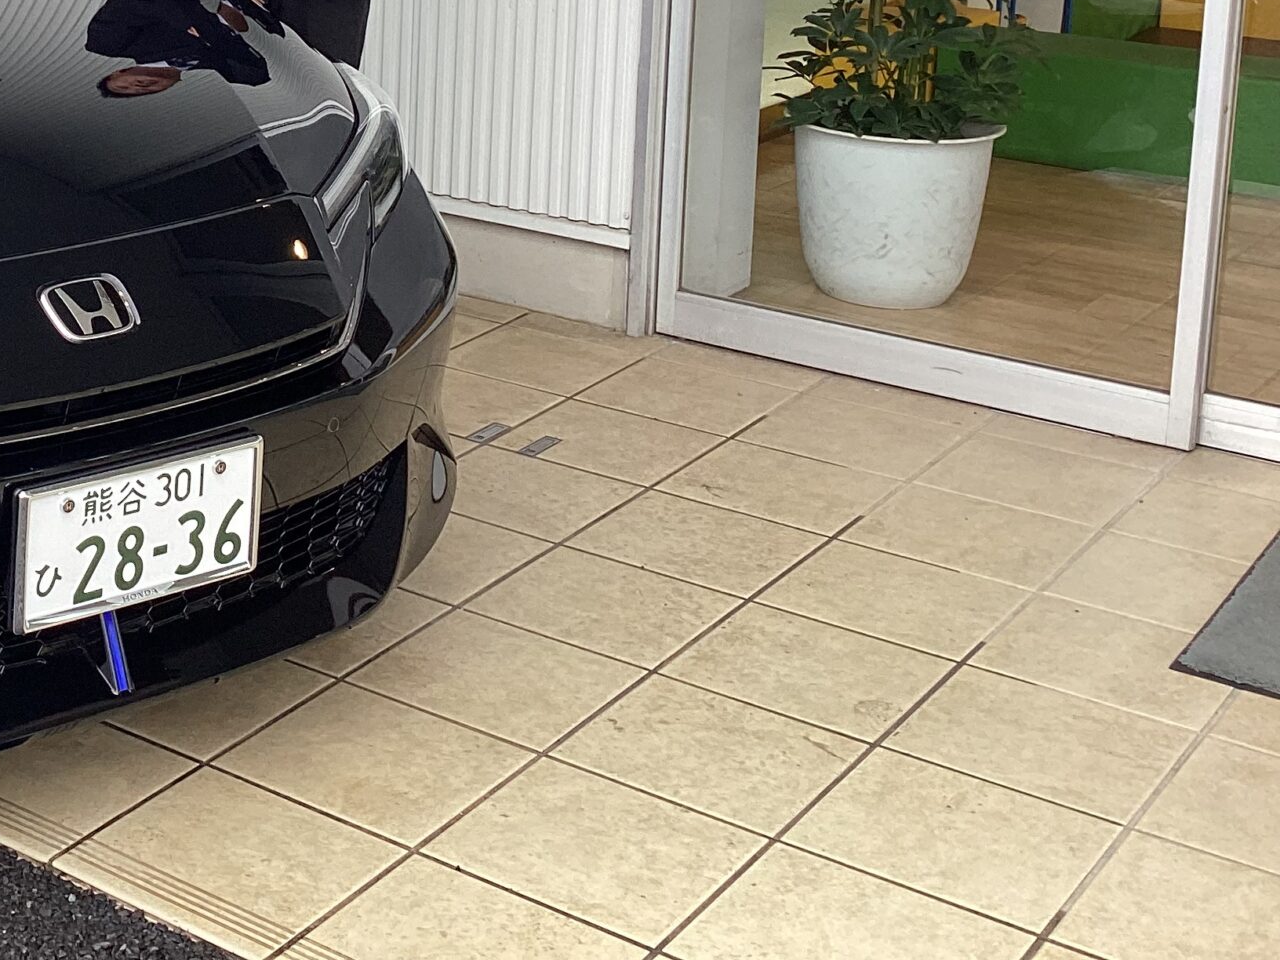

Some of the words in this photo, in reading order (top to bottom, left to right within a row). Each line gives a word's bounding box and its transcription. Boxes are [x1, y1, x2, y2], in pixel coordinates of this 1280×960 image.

[81, 479, 147, 527] 熊谷
[155, 464, 205, 507] 301
[35, 565, 62, 598] ひ
[73, 498, 244, 605] 28-36
[121, 588, 160, 604] HONDA
